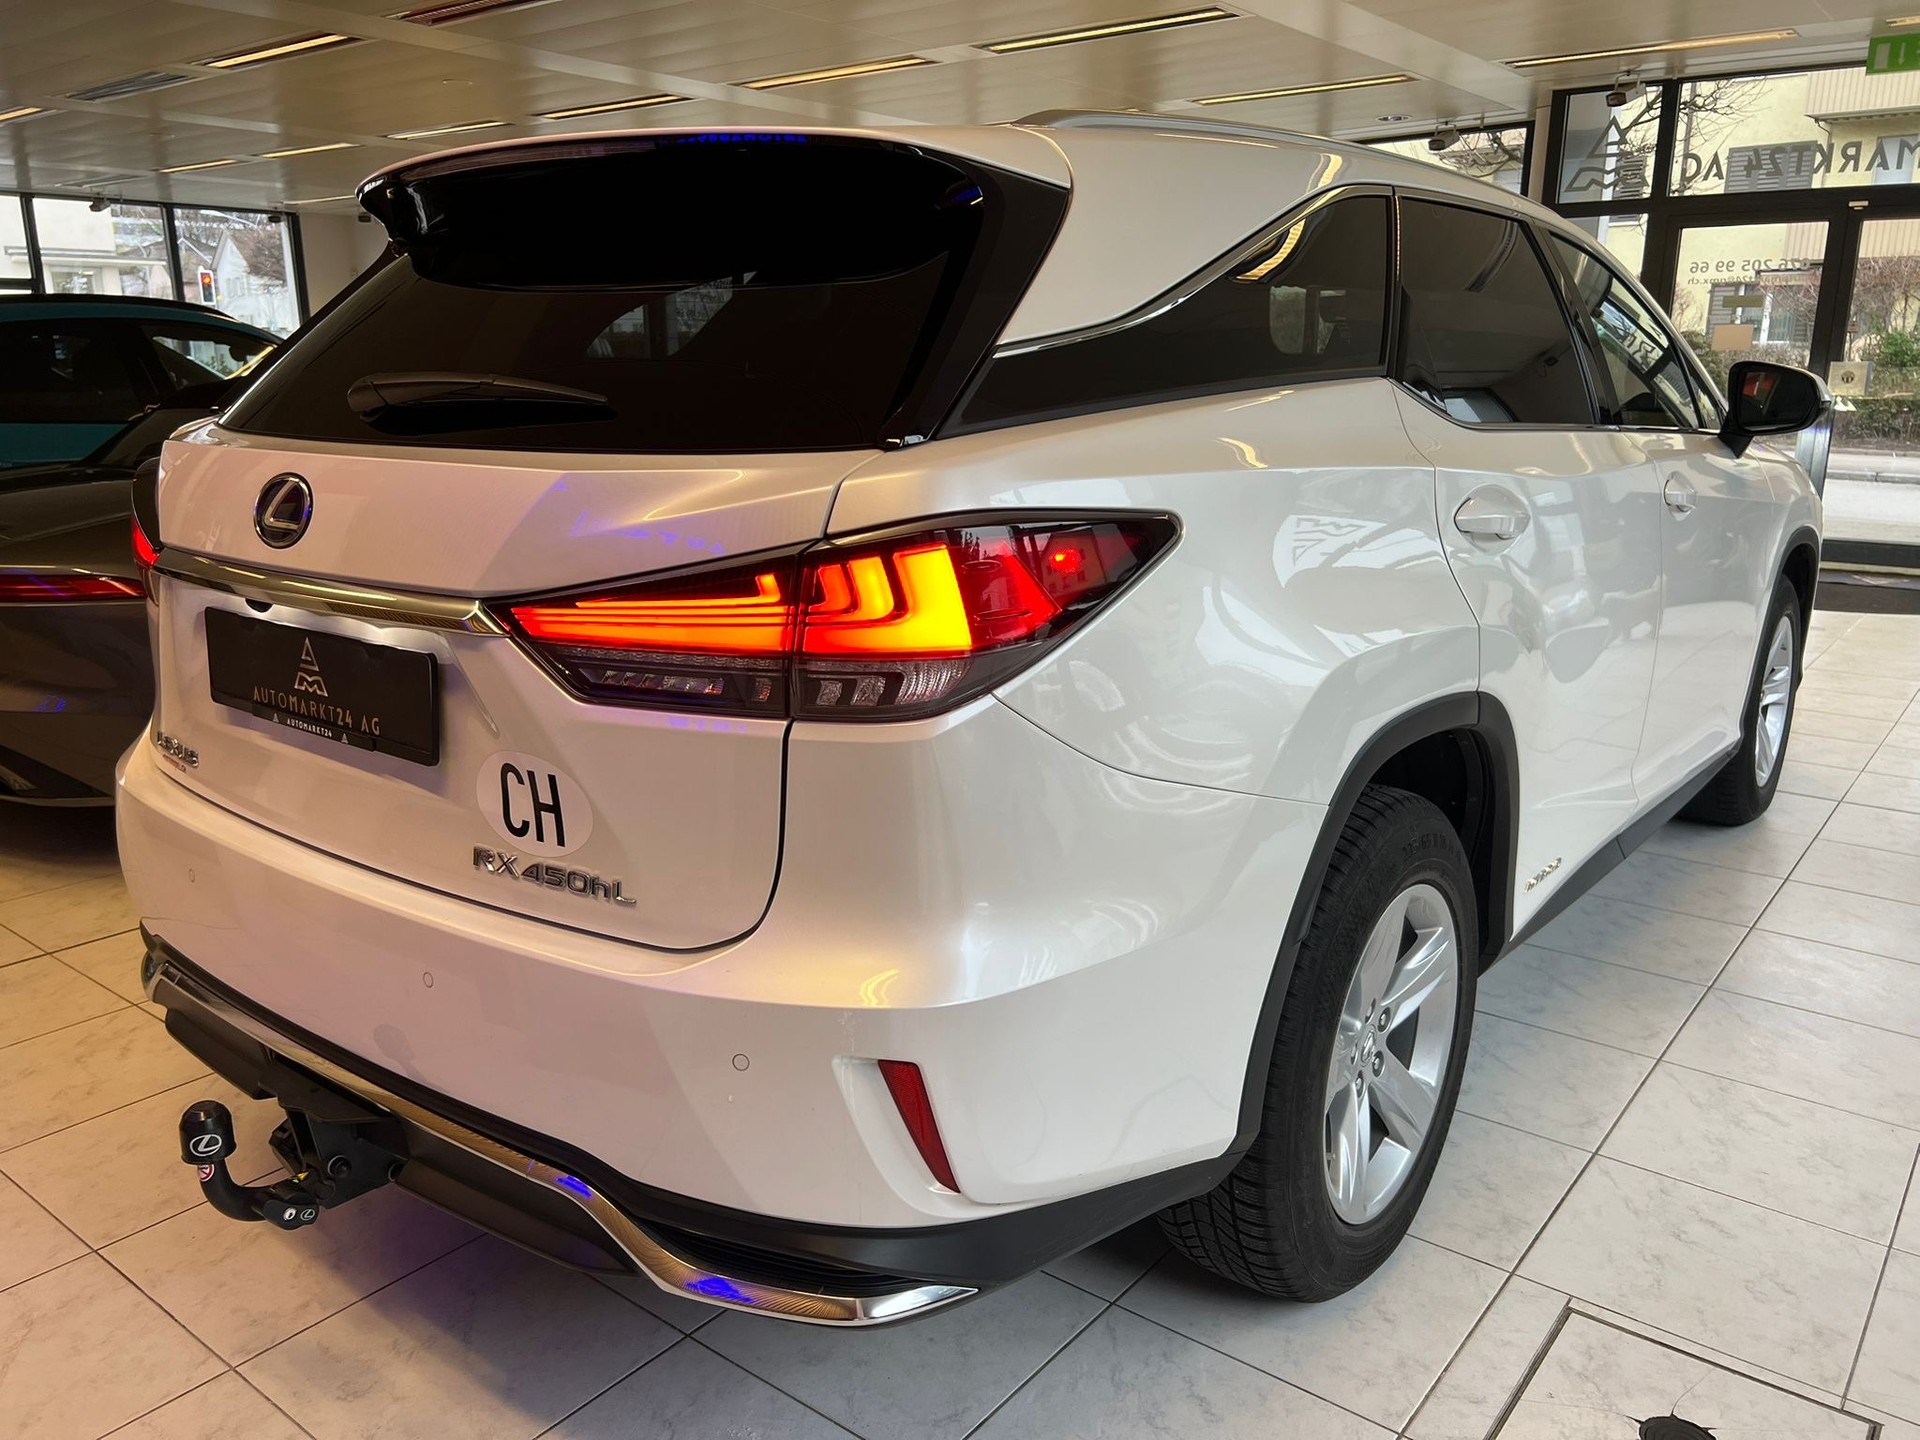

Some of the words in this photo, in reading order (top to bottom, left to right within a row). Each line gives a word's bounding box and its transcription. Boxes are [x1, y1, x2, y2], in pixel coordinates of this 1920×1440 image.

[253, 685, 353, 728] AUTOMARKT24
[360, 714, 381, 735] AG
[286, 717, 333, 737] AUTOMARKT24
[500, 761, 566, 848] CH
